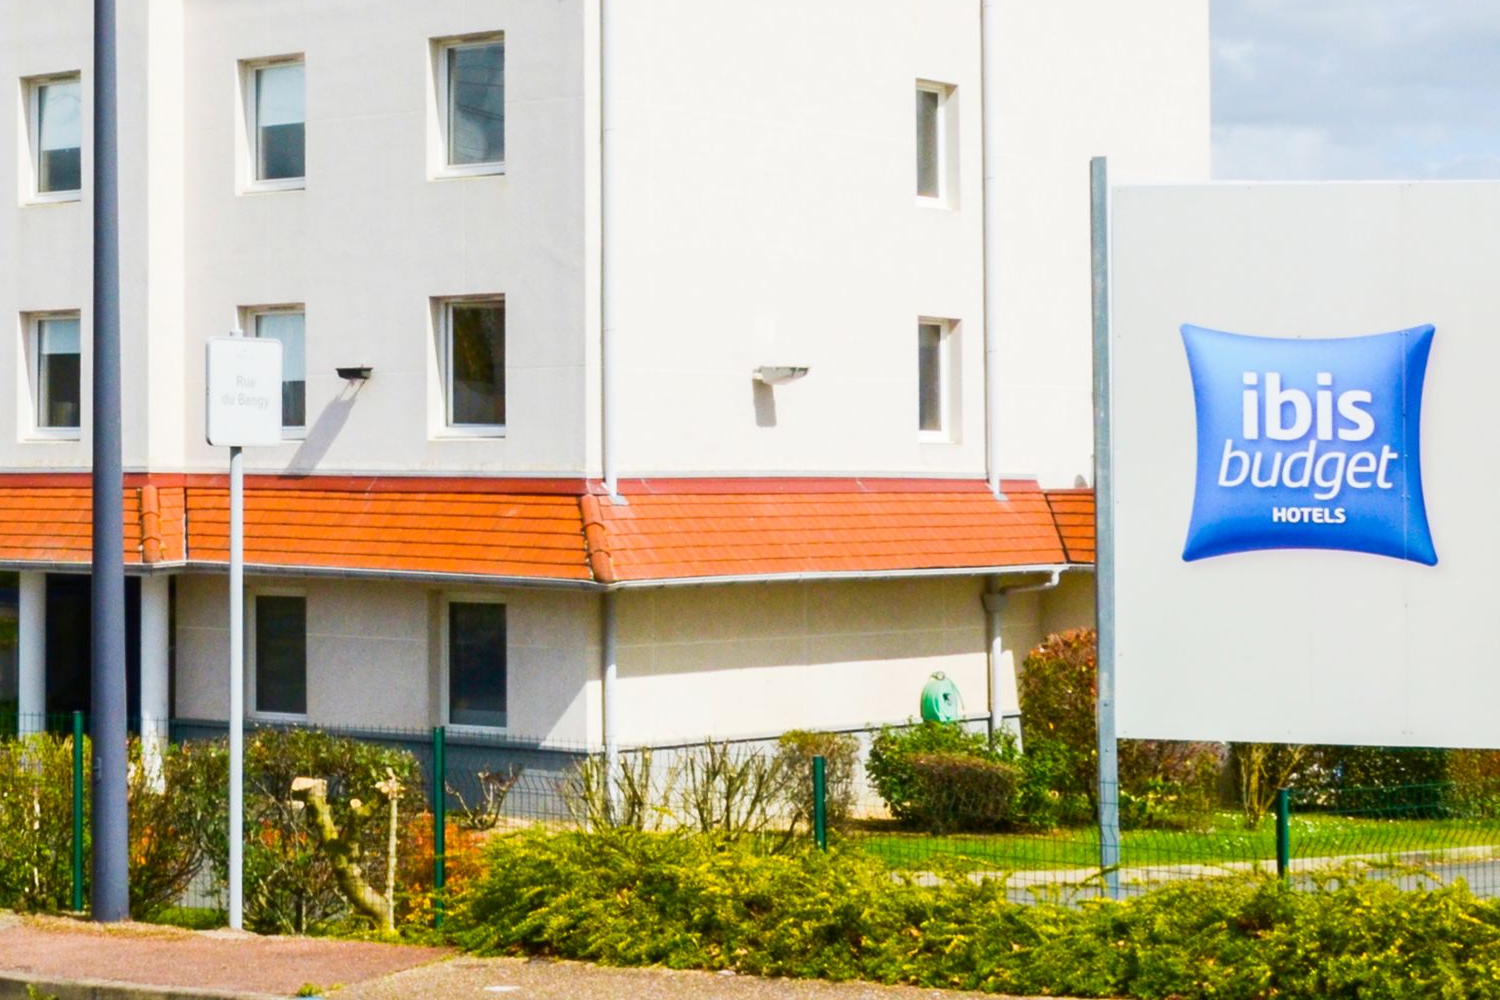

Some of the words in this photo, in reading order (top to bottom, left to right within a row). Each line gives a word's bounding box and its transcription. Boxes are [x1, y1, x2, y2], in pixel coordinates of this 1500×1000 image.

[236, 374, 257, 389] Rue
[221, 392, 236, 406] du
[1241, 371, 1376, 442] ibis
[1216, 438, 1399, 501] budget
[1272, 506, 1347, 524] HOTELS
